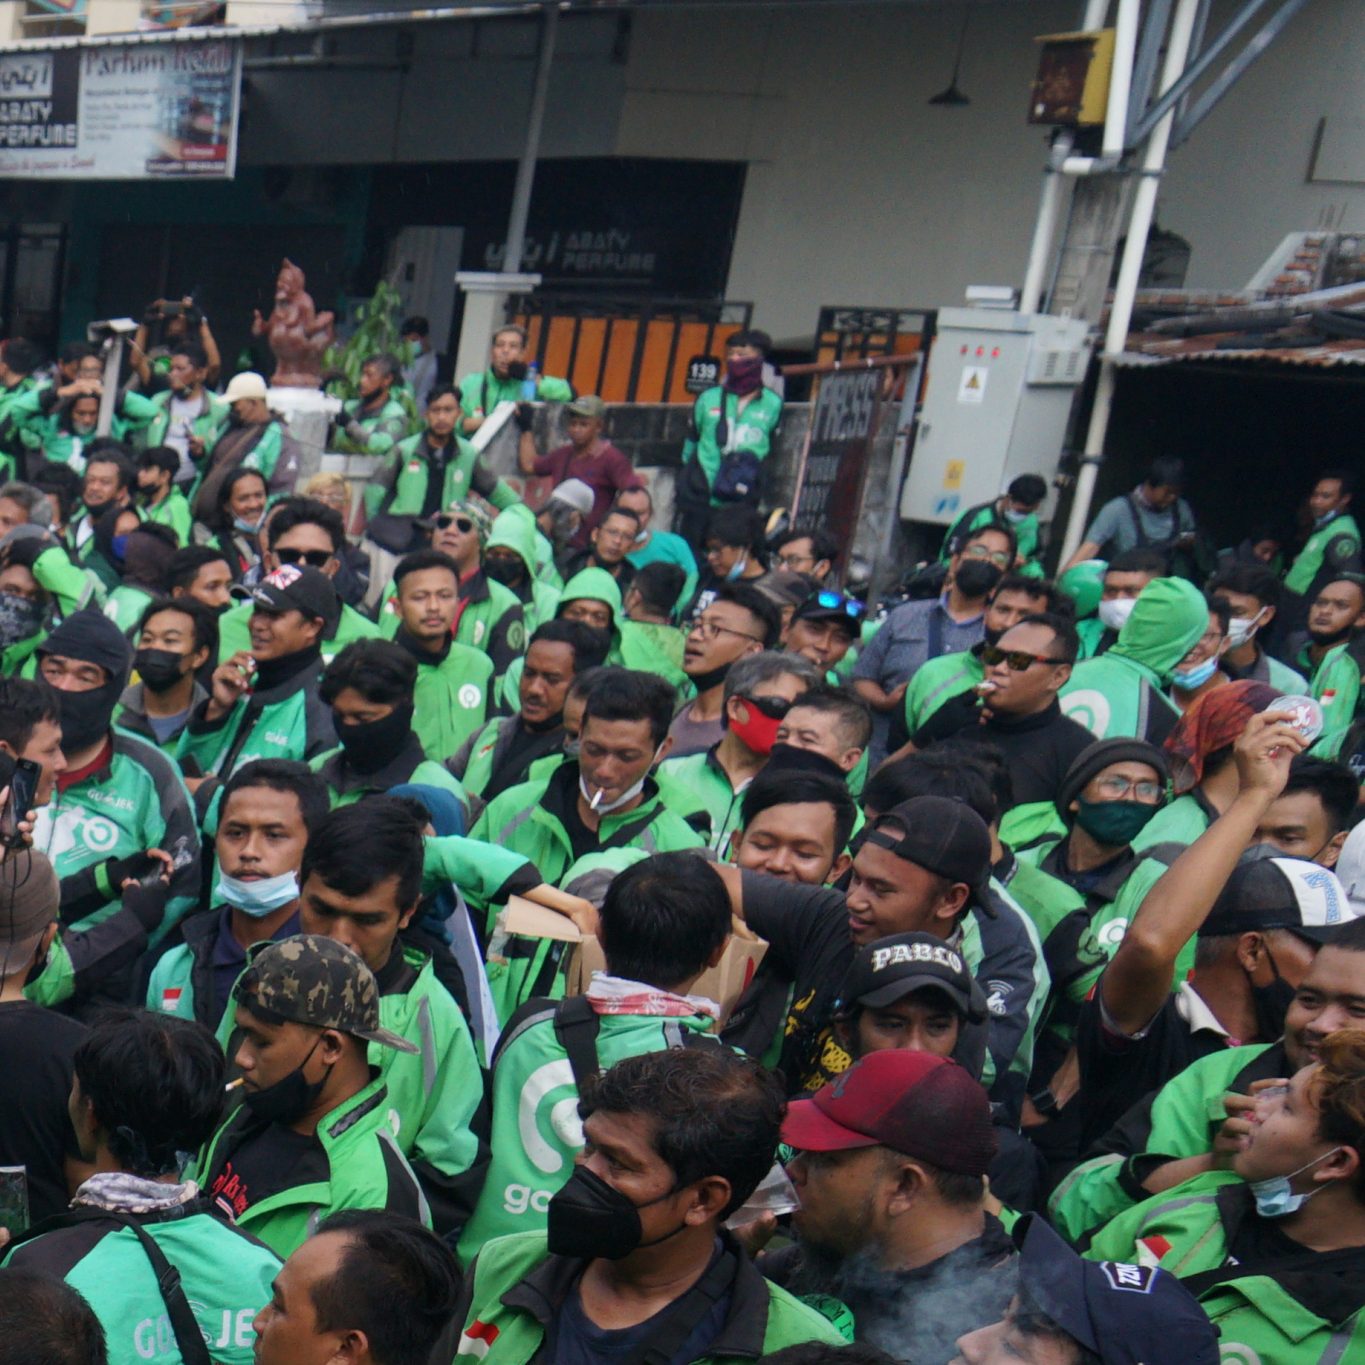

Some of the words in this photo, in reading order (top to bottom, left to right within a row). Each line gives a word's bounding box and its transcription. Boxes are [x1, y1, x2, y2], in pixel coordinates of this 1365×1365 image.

[690, 362, 717, 380] 139
[871, 942, 963, 974] PABLO
[216, 1308, 259, 1349] JE
